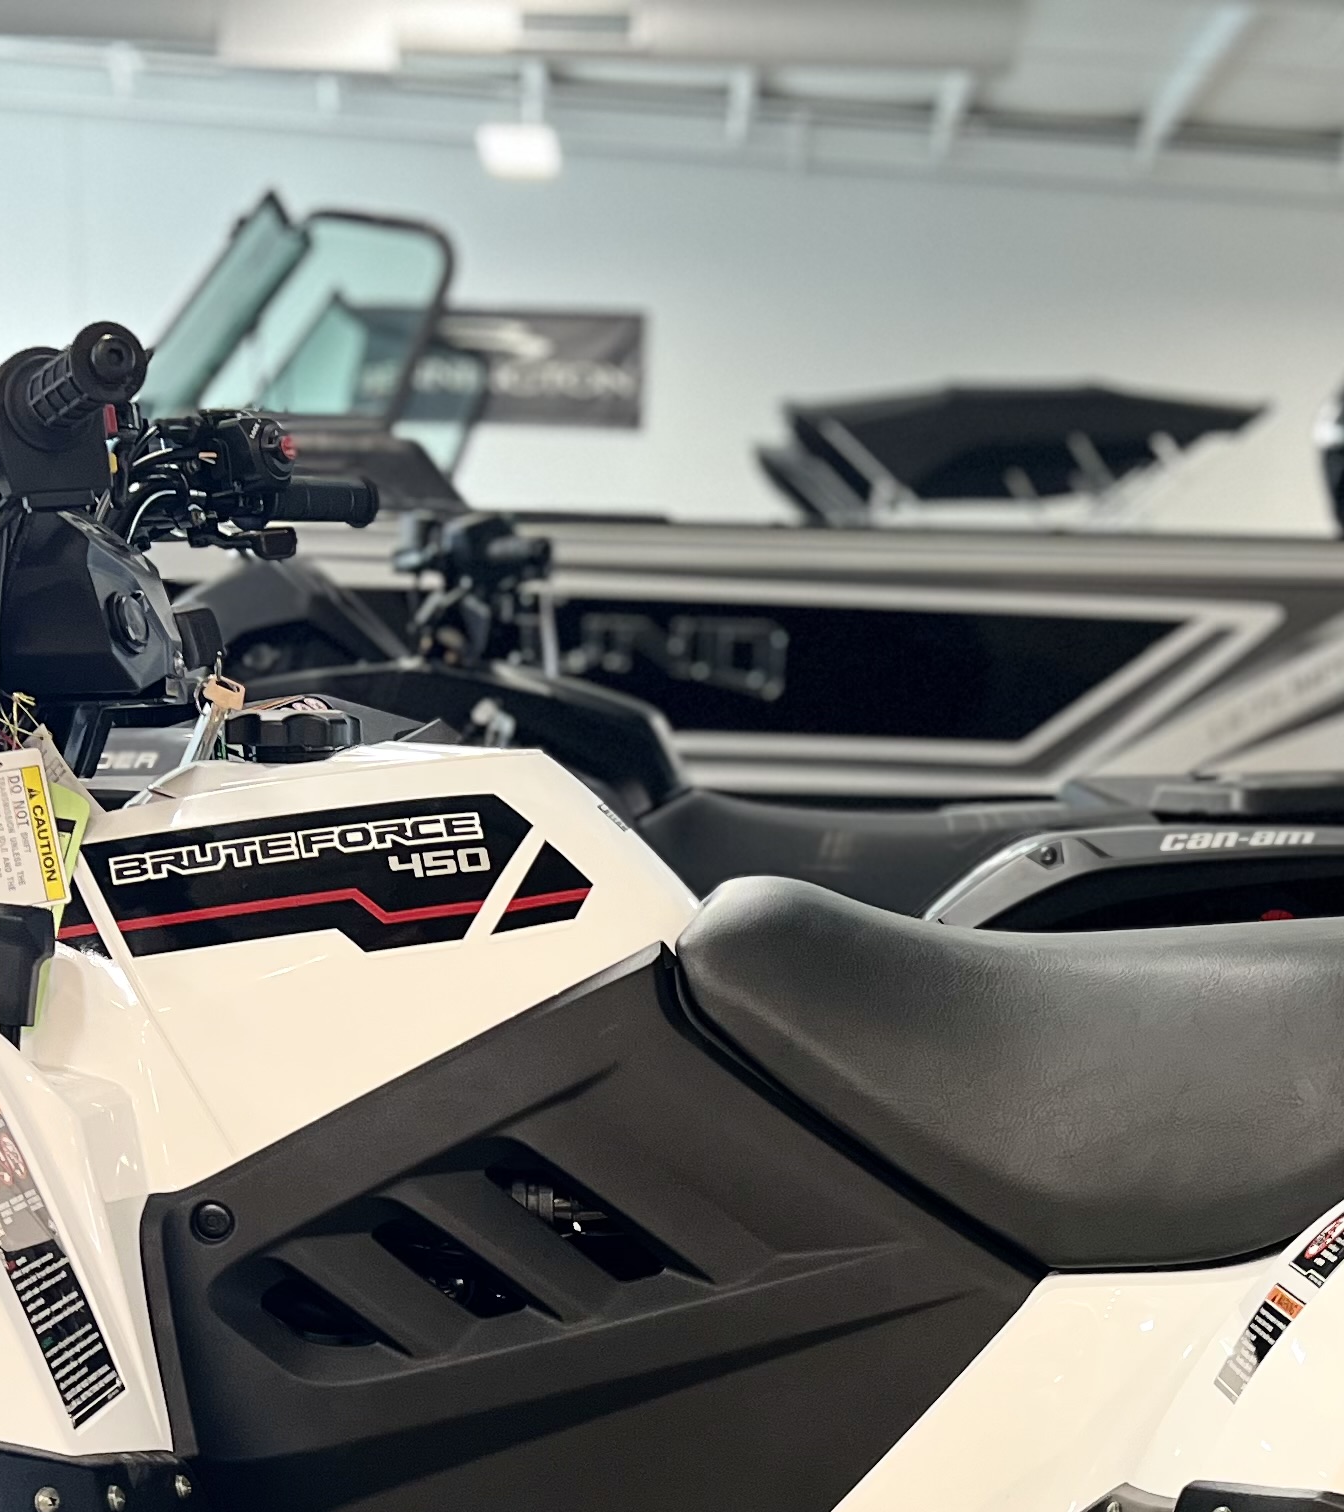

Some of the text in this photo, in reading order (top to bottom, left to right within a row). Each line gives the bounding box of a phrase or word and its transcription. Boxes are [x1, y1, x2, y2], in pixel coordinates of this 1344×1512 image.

[8, 776, 23, 793] DO
[16, 800, 29, 827] NOT
[33, 805, 58, 881] CAUTION
[109, 812, 485, 886] BRUTE FORCE
[387, 846, 490, 879] 450
[1159, 831, 1317, 852] can-am
